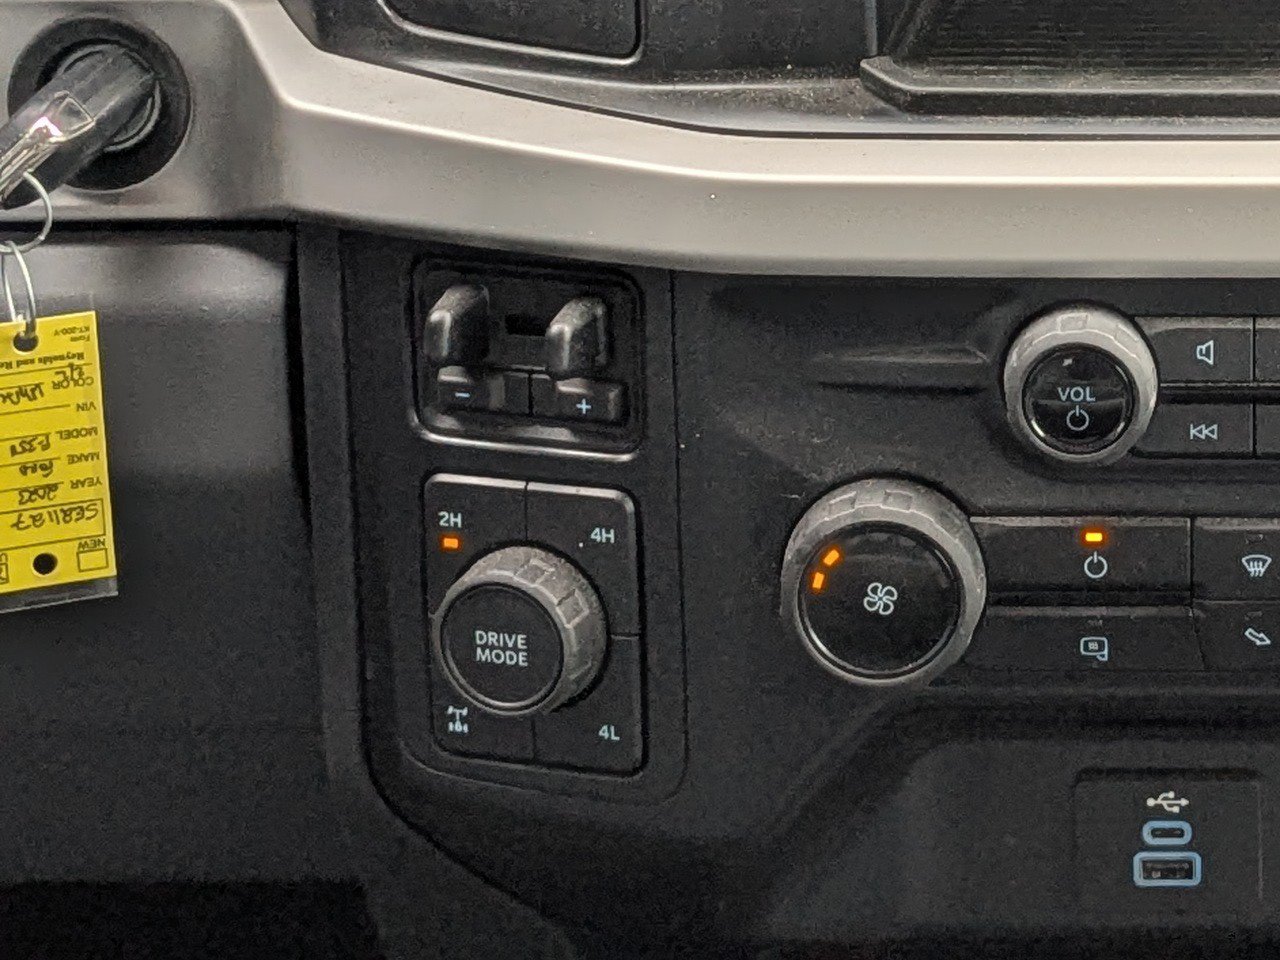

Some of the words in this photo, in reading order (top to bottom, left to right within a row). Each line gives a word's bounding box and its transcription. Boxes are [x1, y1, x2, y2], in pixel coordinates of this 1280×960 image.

[1058, 387, 1096, 402] VOL
[76, 402, 96, 411] VIN
[55, 427, 98, 440] MODEL
[67, 452, 99, 464] MAKE
[70, 477, 102, 489] YEAR
[438, 511, 462, 527] 2H
[591, 527, 615, 544] 4H
[77, 538, 106, 551] NEW
[475, 631, 528, 650] DRIVE
[476, 647, 528, 667] MODE
[598, 725, 620, 741] 4L
